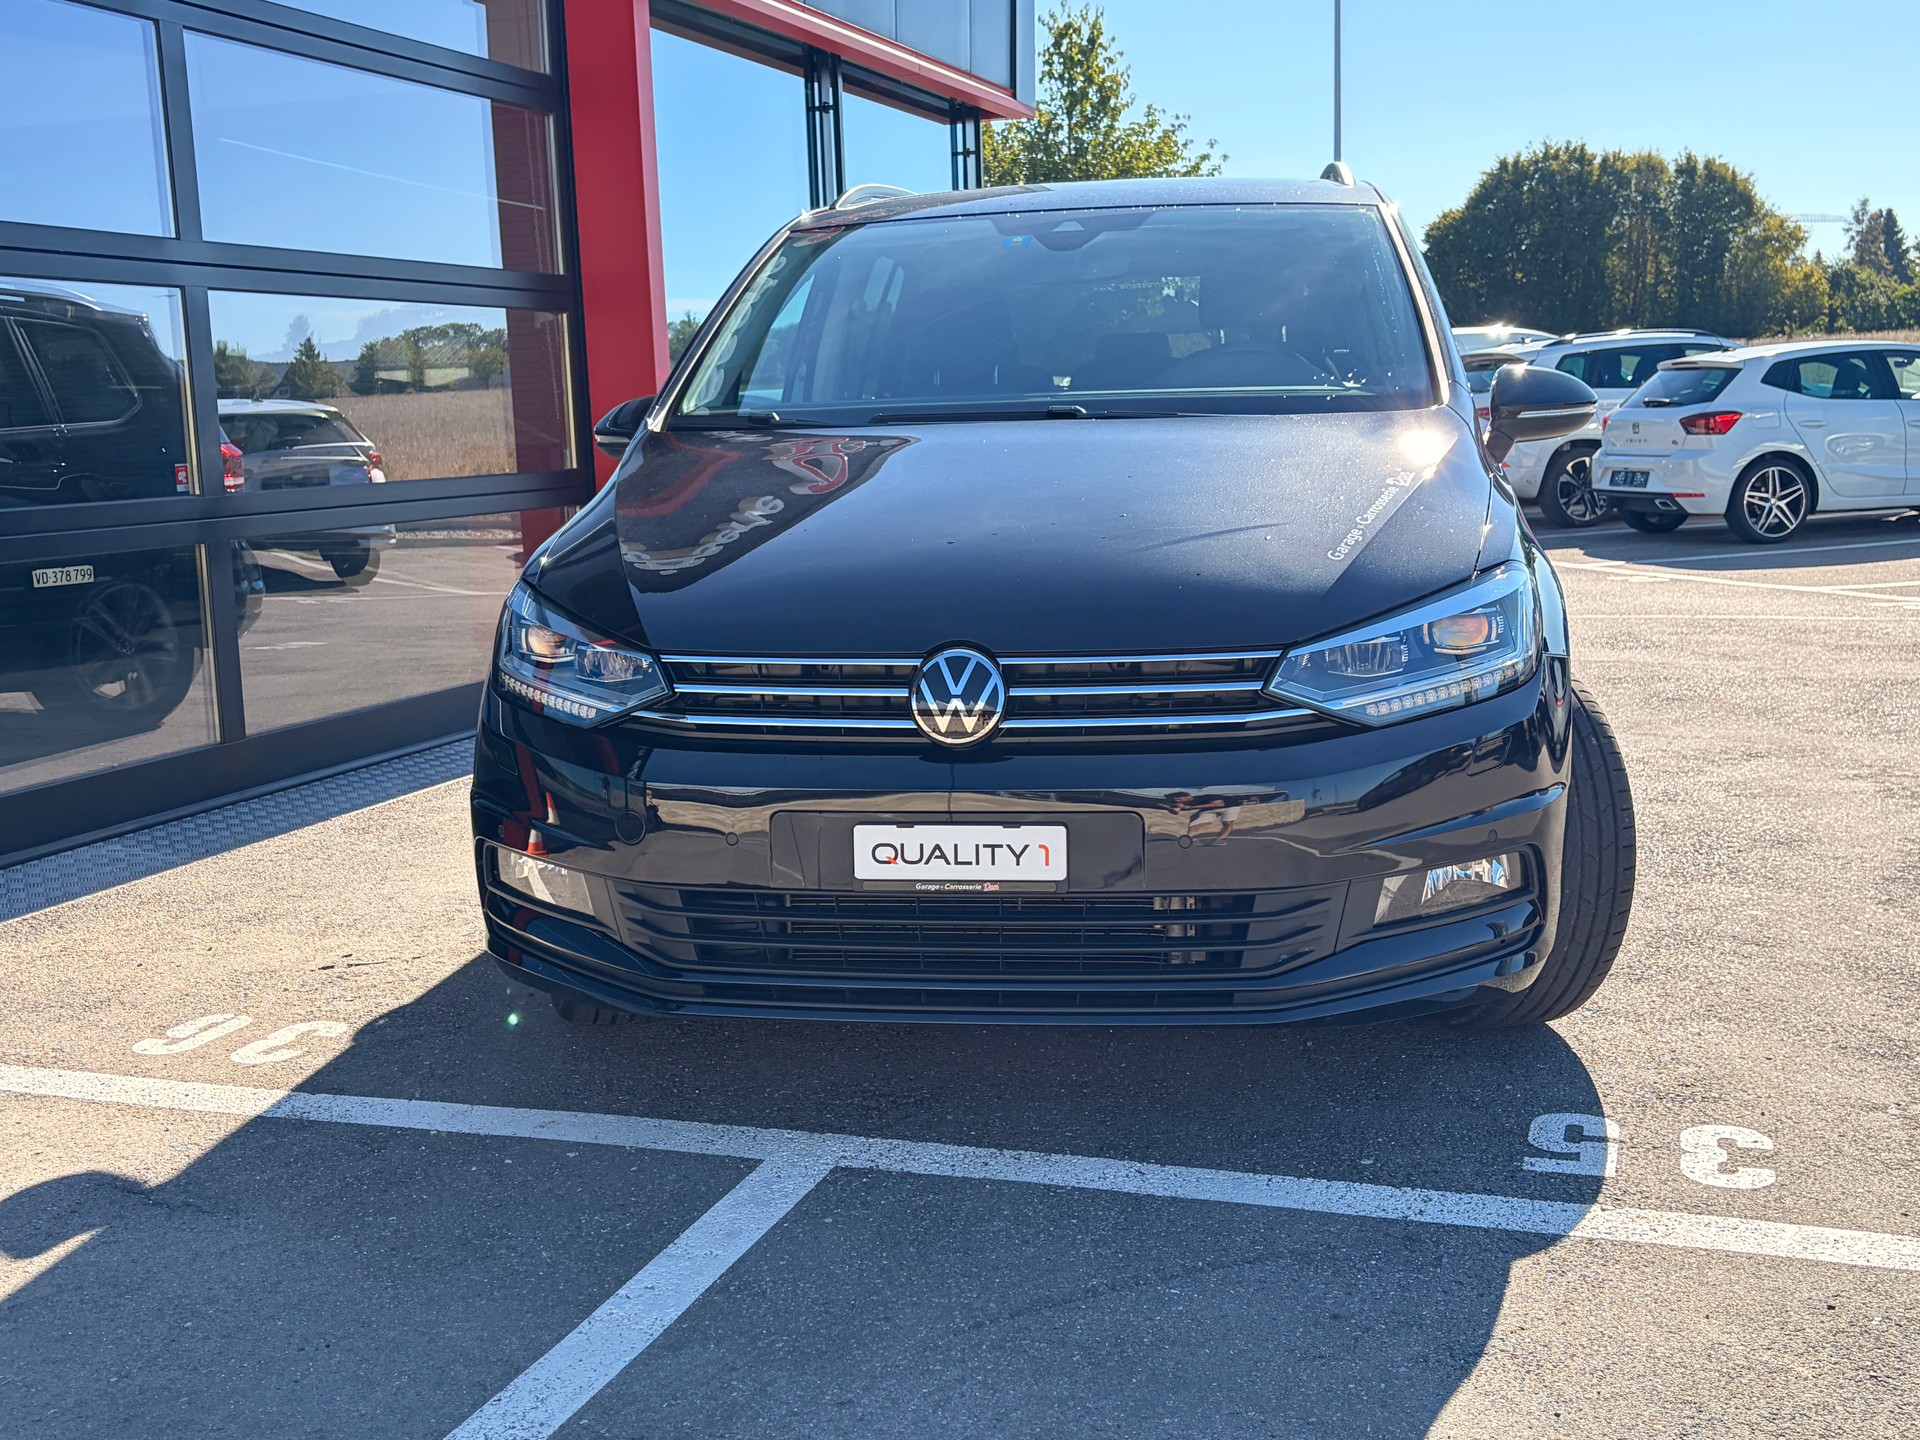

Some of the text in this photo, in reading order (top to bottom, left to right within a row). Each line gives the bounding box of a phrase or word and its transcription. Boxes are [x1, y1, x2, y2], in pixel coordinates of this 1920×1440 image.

[1327, 528, 1363, 561] Garage
[1356, 485, 1400, 525] Carrosserie
[871, 842, 1030, 866] QUALITY
[915, 882, 940, 891] Garage
[944, 882, 982, 891] Carrosserie
